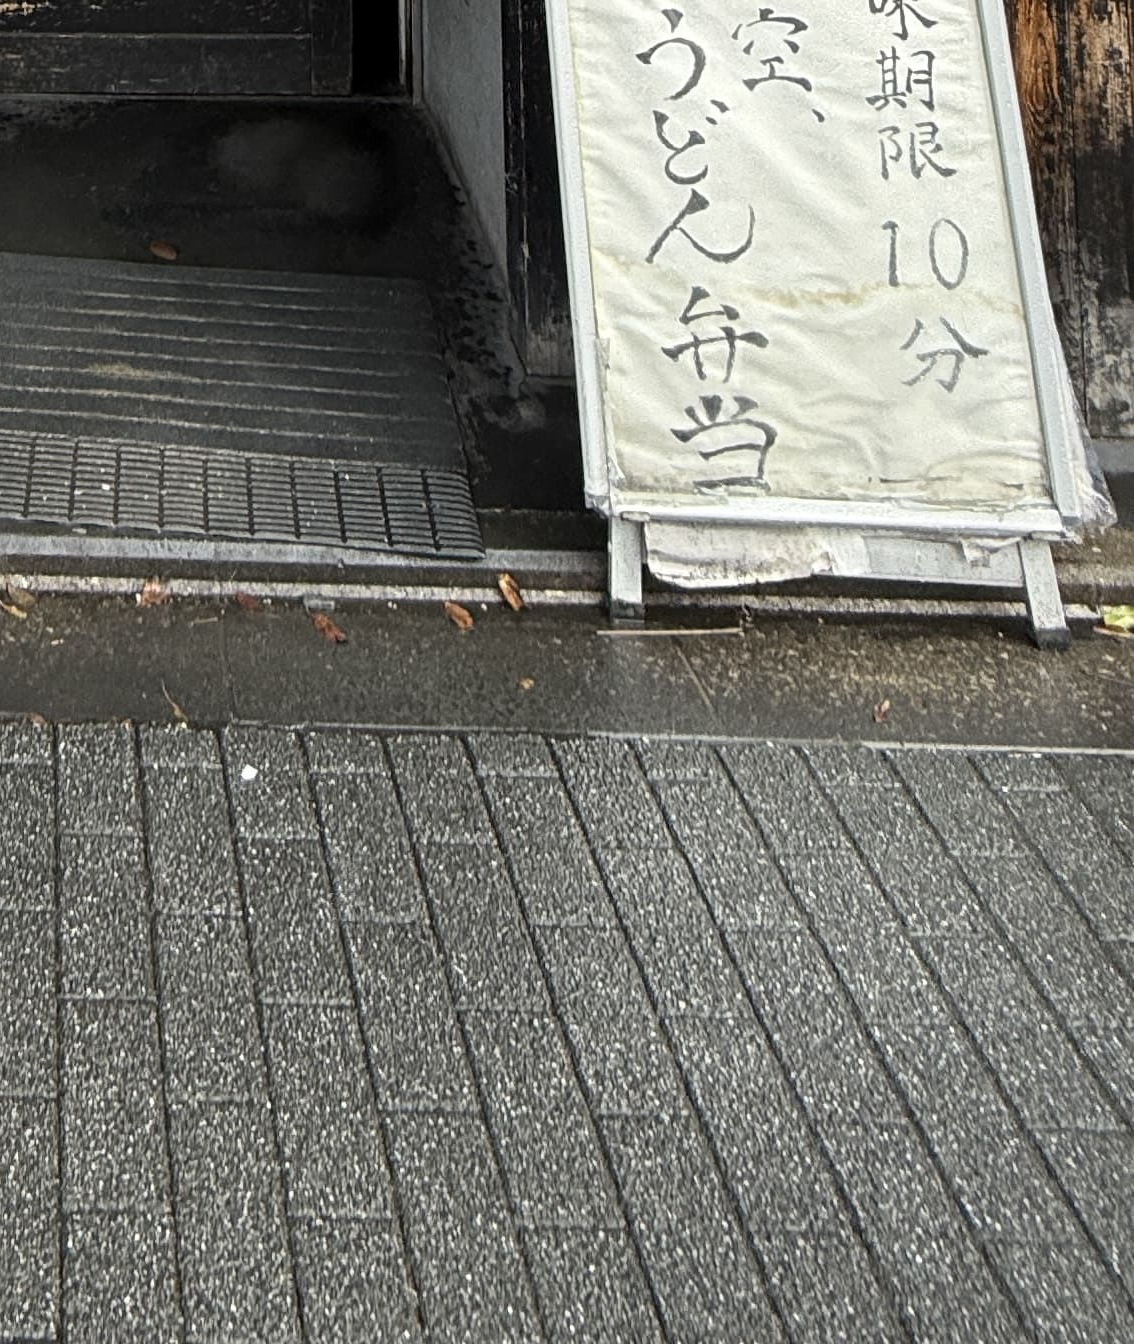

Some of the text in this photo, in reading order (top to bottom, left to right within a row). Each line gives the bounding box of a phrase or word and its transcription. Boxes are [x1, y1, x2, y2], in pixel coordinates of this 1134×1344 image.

[635, 8, 778, 492] うどん弁当
